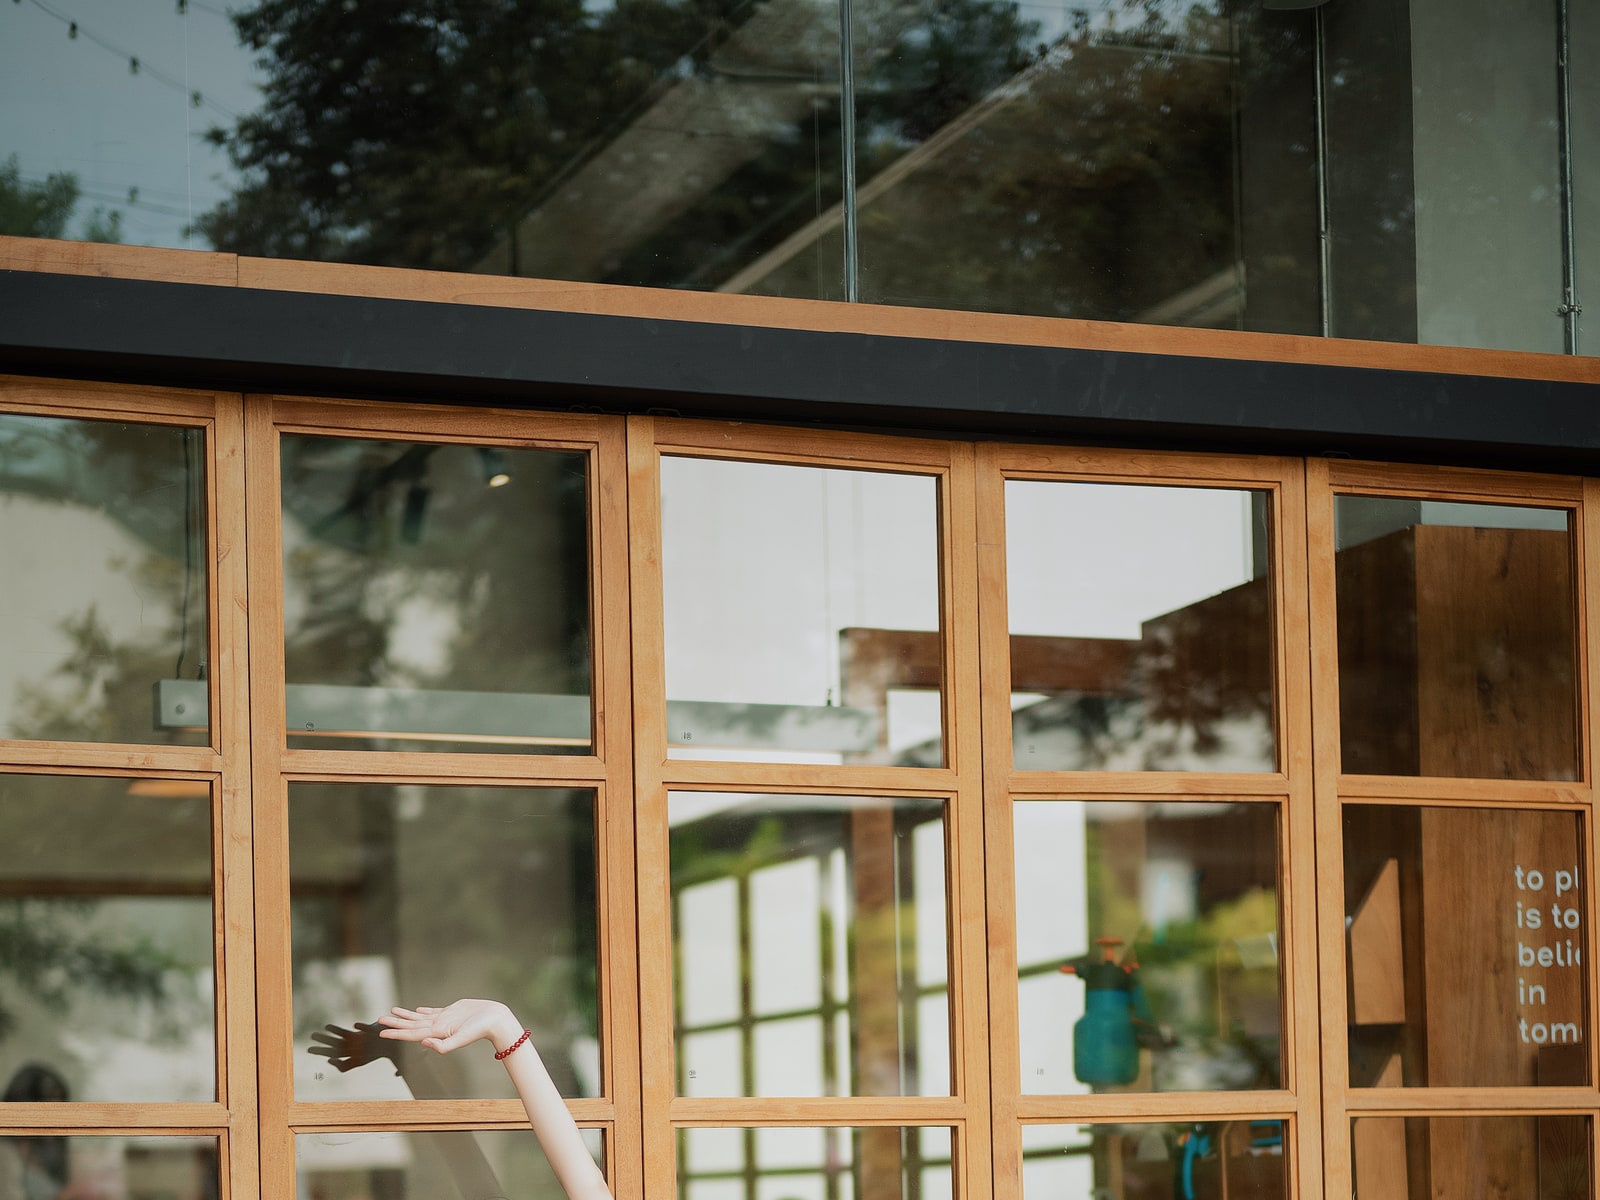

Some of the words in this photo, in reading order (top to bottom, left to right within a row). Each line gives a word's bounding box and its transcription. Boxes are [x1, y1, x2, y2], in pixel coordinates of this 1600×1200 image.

[1515, 865, 1544, 891] to
[1516, 901, 1542, 929] is
[1552, 903, 1580, 930] to
[1519, 977, 1546, 1005] in
[1519, 1018, 1583, 1044] tom
